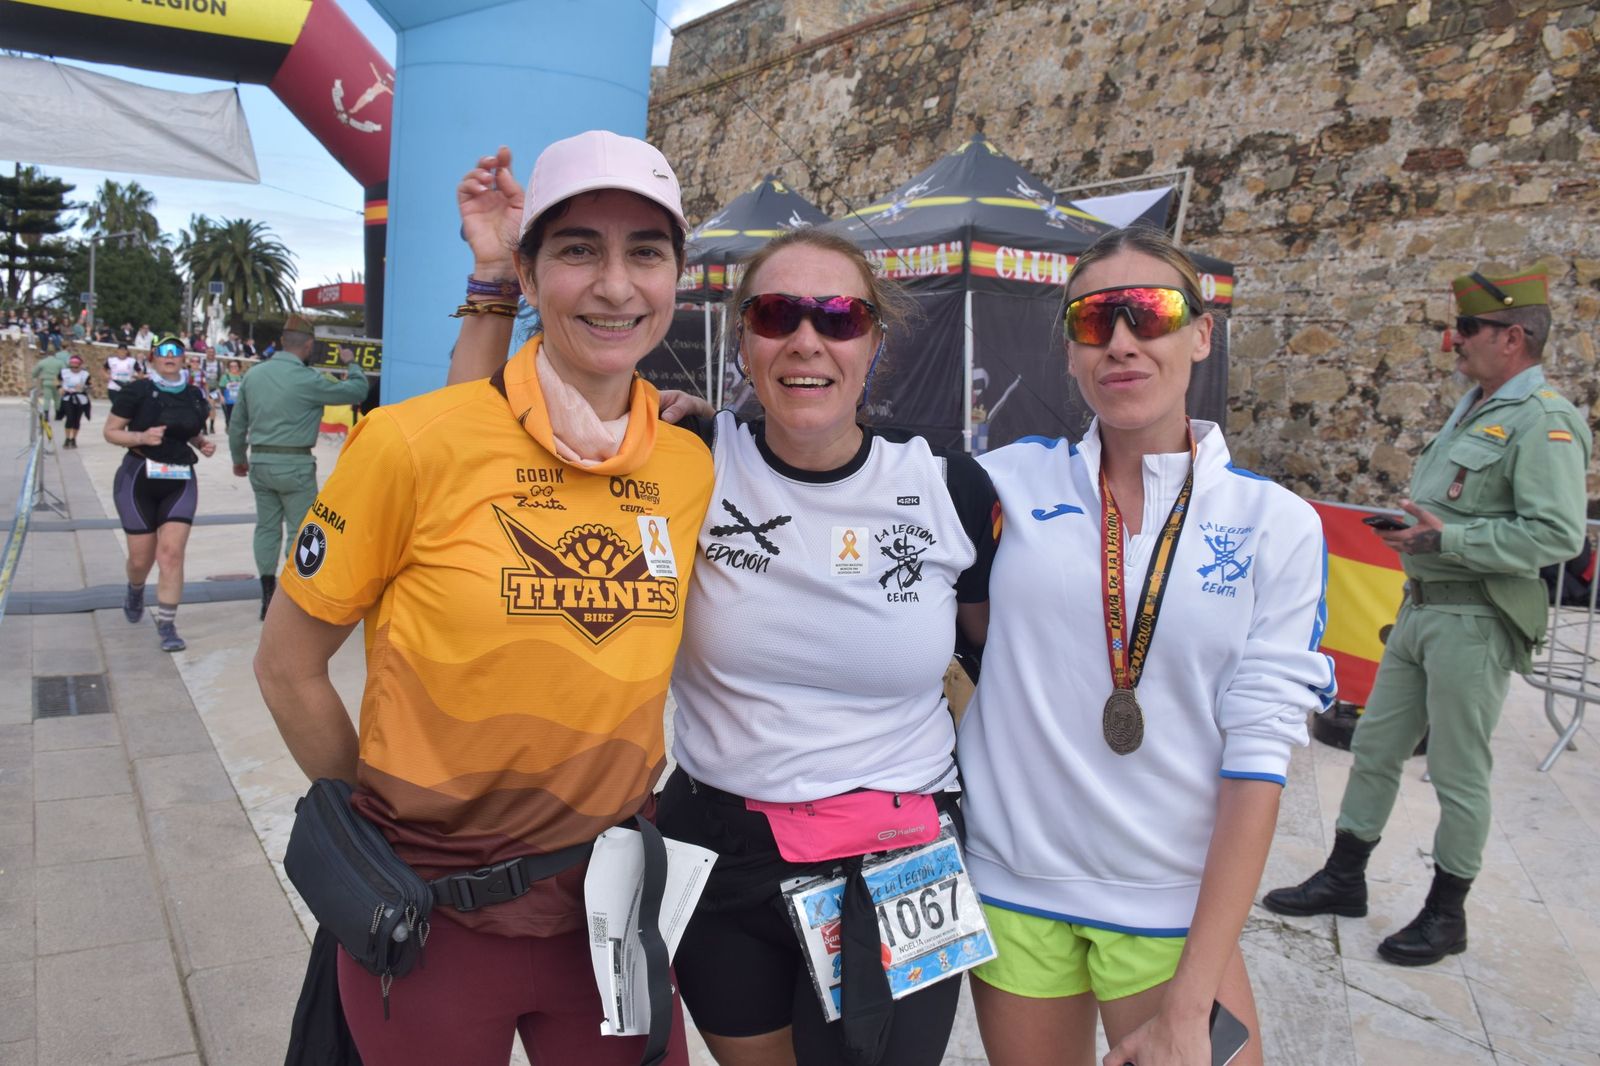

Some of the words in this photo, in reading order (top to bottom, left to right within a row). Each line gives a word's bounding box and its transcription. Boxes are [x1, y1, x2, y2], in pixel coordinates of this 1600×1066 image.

[995, 246, 1070, 285] CLUB
[516, 468, 564, 483] GOBIK
[512, 495, 567, 511] Zurita
[898, 497, 919, 505] 42K
[620, 504, 646, 514] CEUTA
[1199, 521, 1213, 532] LA
[874, 528, 890, 544] LA
[510, 575, 677, 612] TITANES
[886, 591, 920, 603] CEUTA
[1201, 581, 1237, 598] CEUTA
[583, 613, 614, 623] BIKE
[877, 877, 960, 948] 1067
[898, 939, 925, 954] NOELIA
